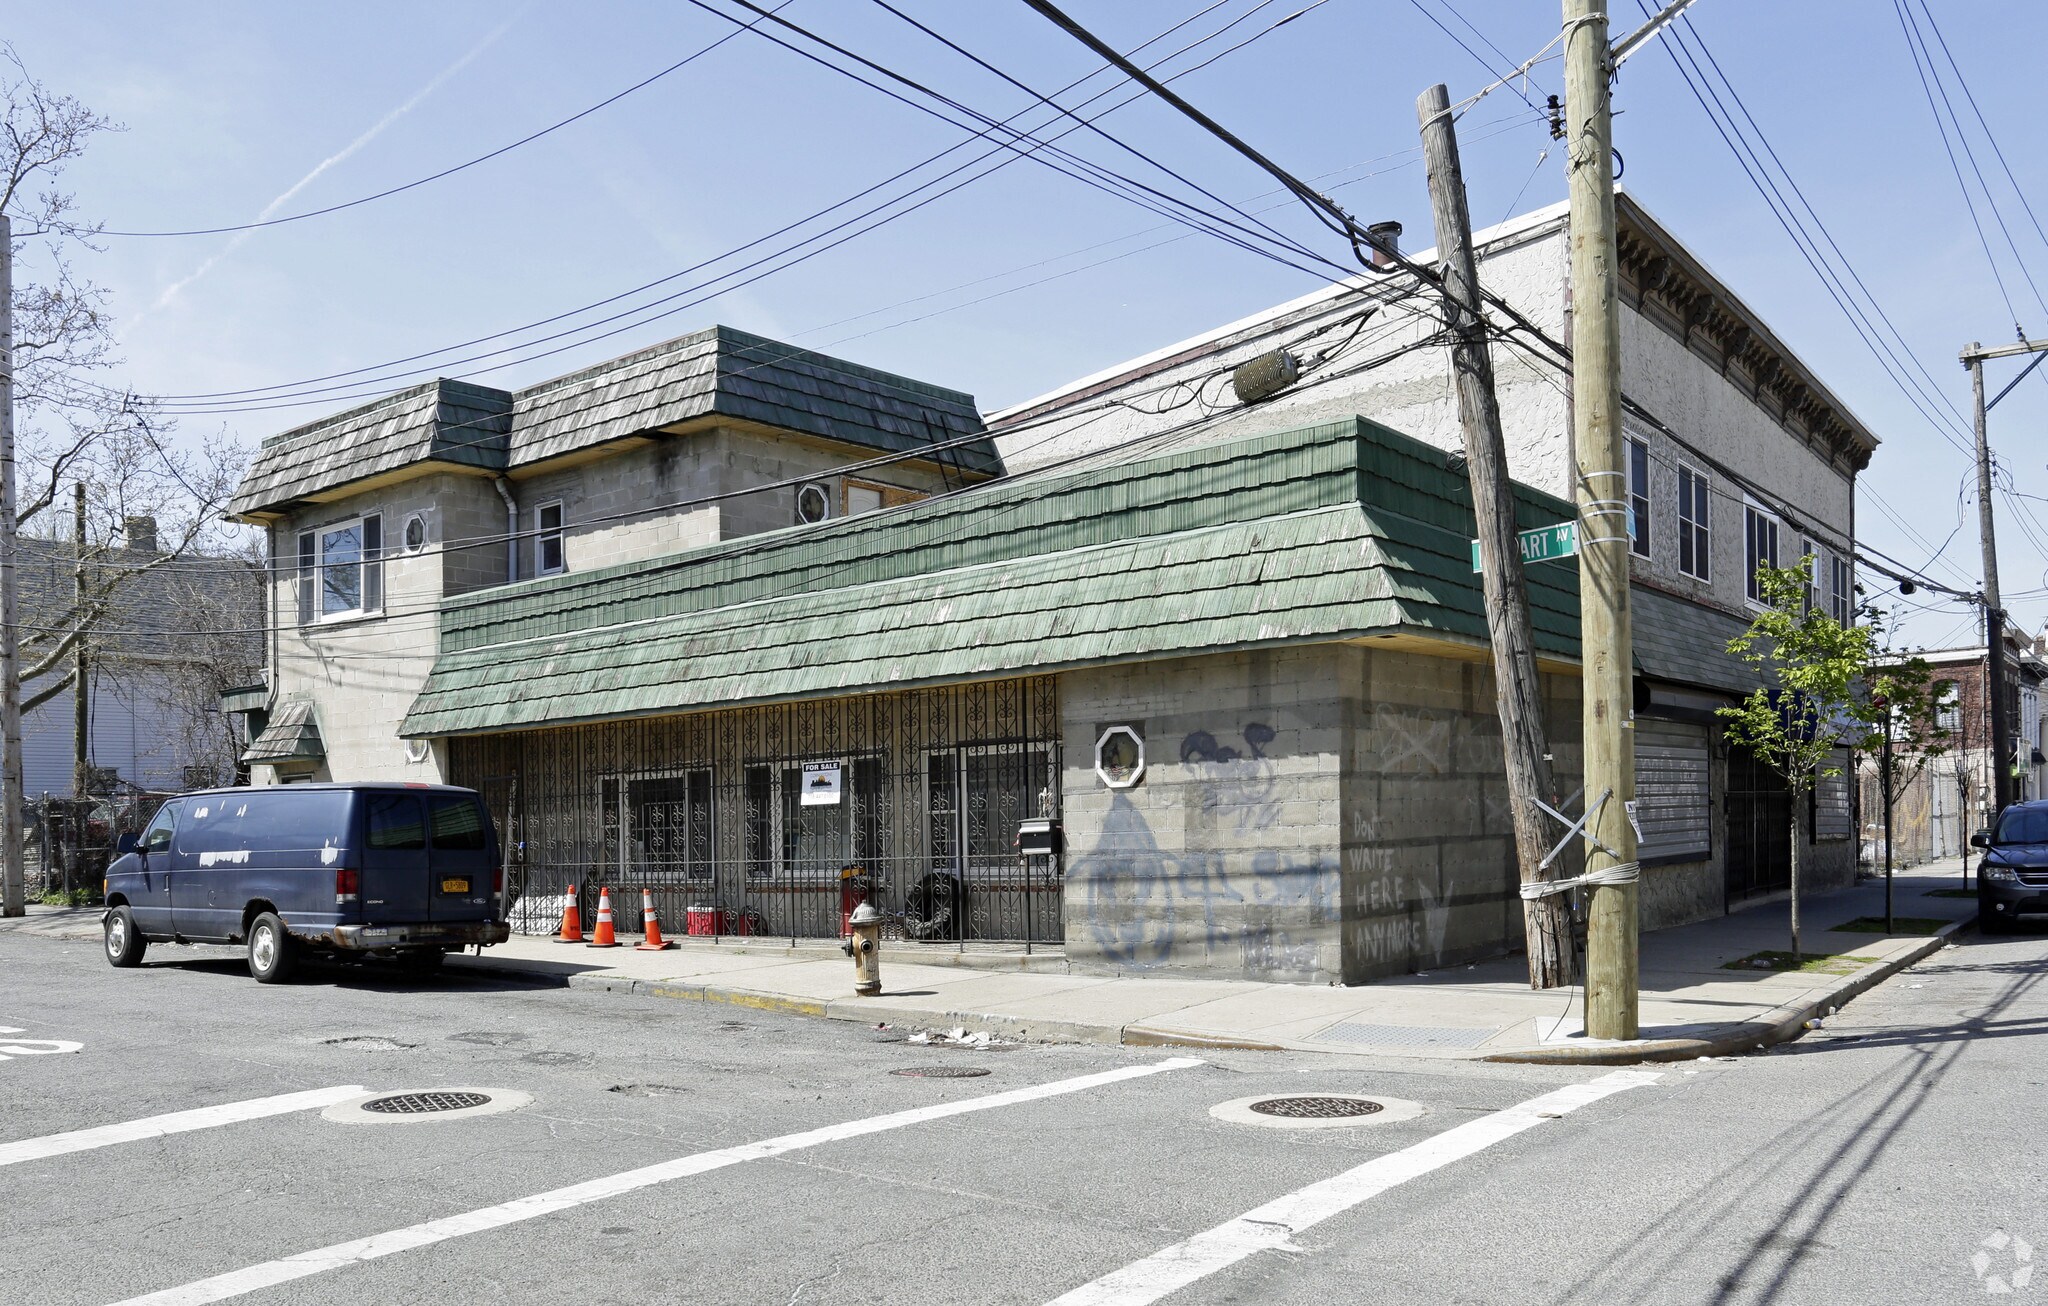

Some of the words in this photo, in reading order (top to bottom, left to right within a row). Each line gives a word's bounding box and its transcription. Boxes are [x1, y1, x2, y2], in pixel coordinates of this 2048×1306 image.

[1556, 527, 1569, 543] AV
[1356, 876, 1404, 914] HERE
[1356, 917, 1421, 961] ANYMORE
